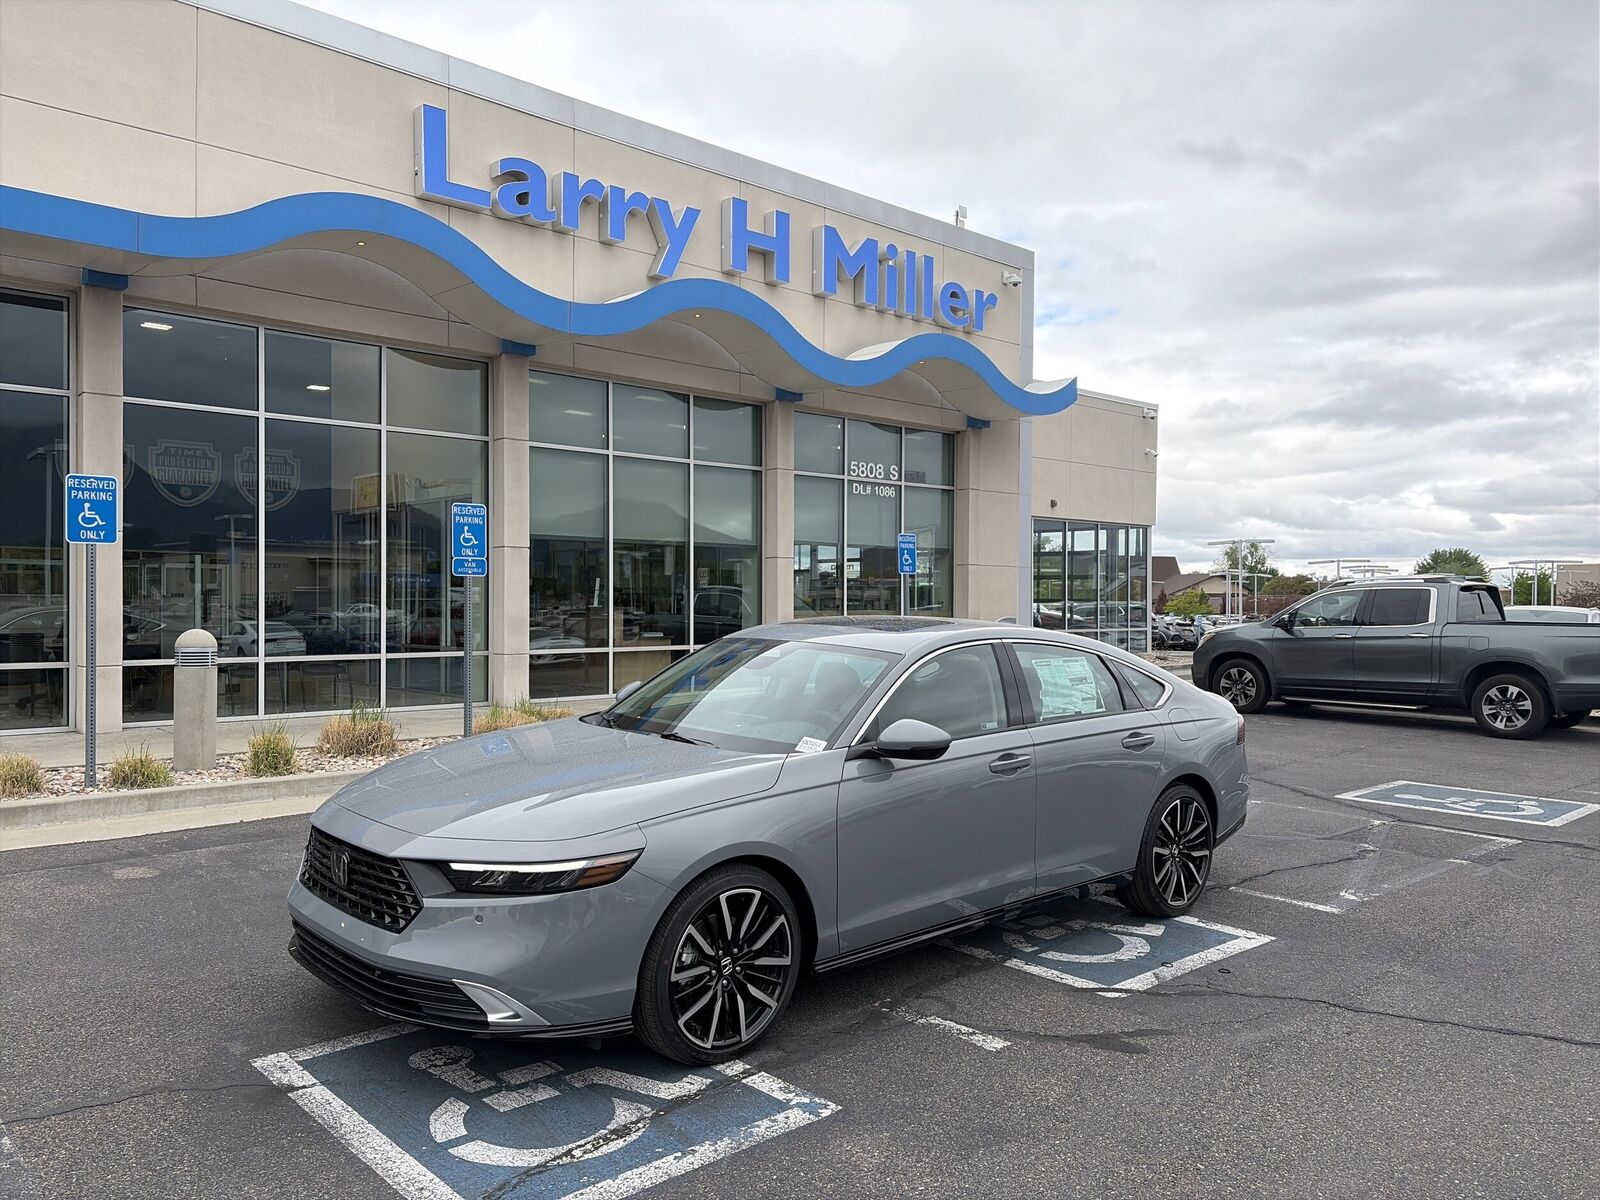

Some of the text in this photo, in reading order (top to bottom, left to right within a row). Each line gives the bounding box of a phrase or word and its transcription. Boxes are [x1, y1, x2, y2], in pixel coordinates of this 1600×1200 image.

[414, 103, 998, 333] Larry H Miller
[159, 455, 213, 469] PROTECTION
[157, 468, 213, 485] GUARANTEE
[850, 461, 884, 479] 5808
[889, 465, 898, 480] S
[68, 478, 116, 490] RESERVED
[852, 483, 895, 497] DL# 1086
[71, 490, 113, 501] PARKING
[453, 506, 485, 516] RESERVED
[455, 516, 483, 525] PARKING
[80, 529, 105, 540] ONLY
[461, 548, 479, 556] ONLY
